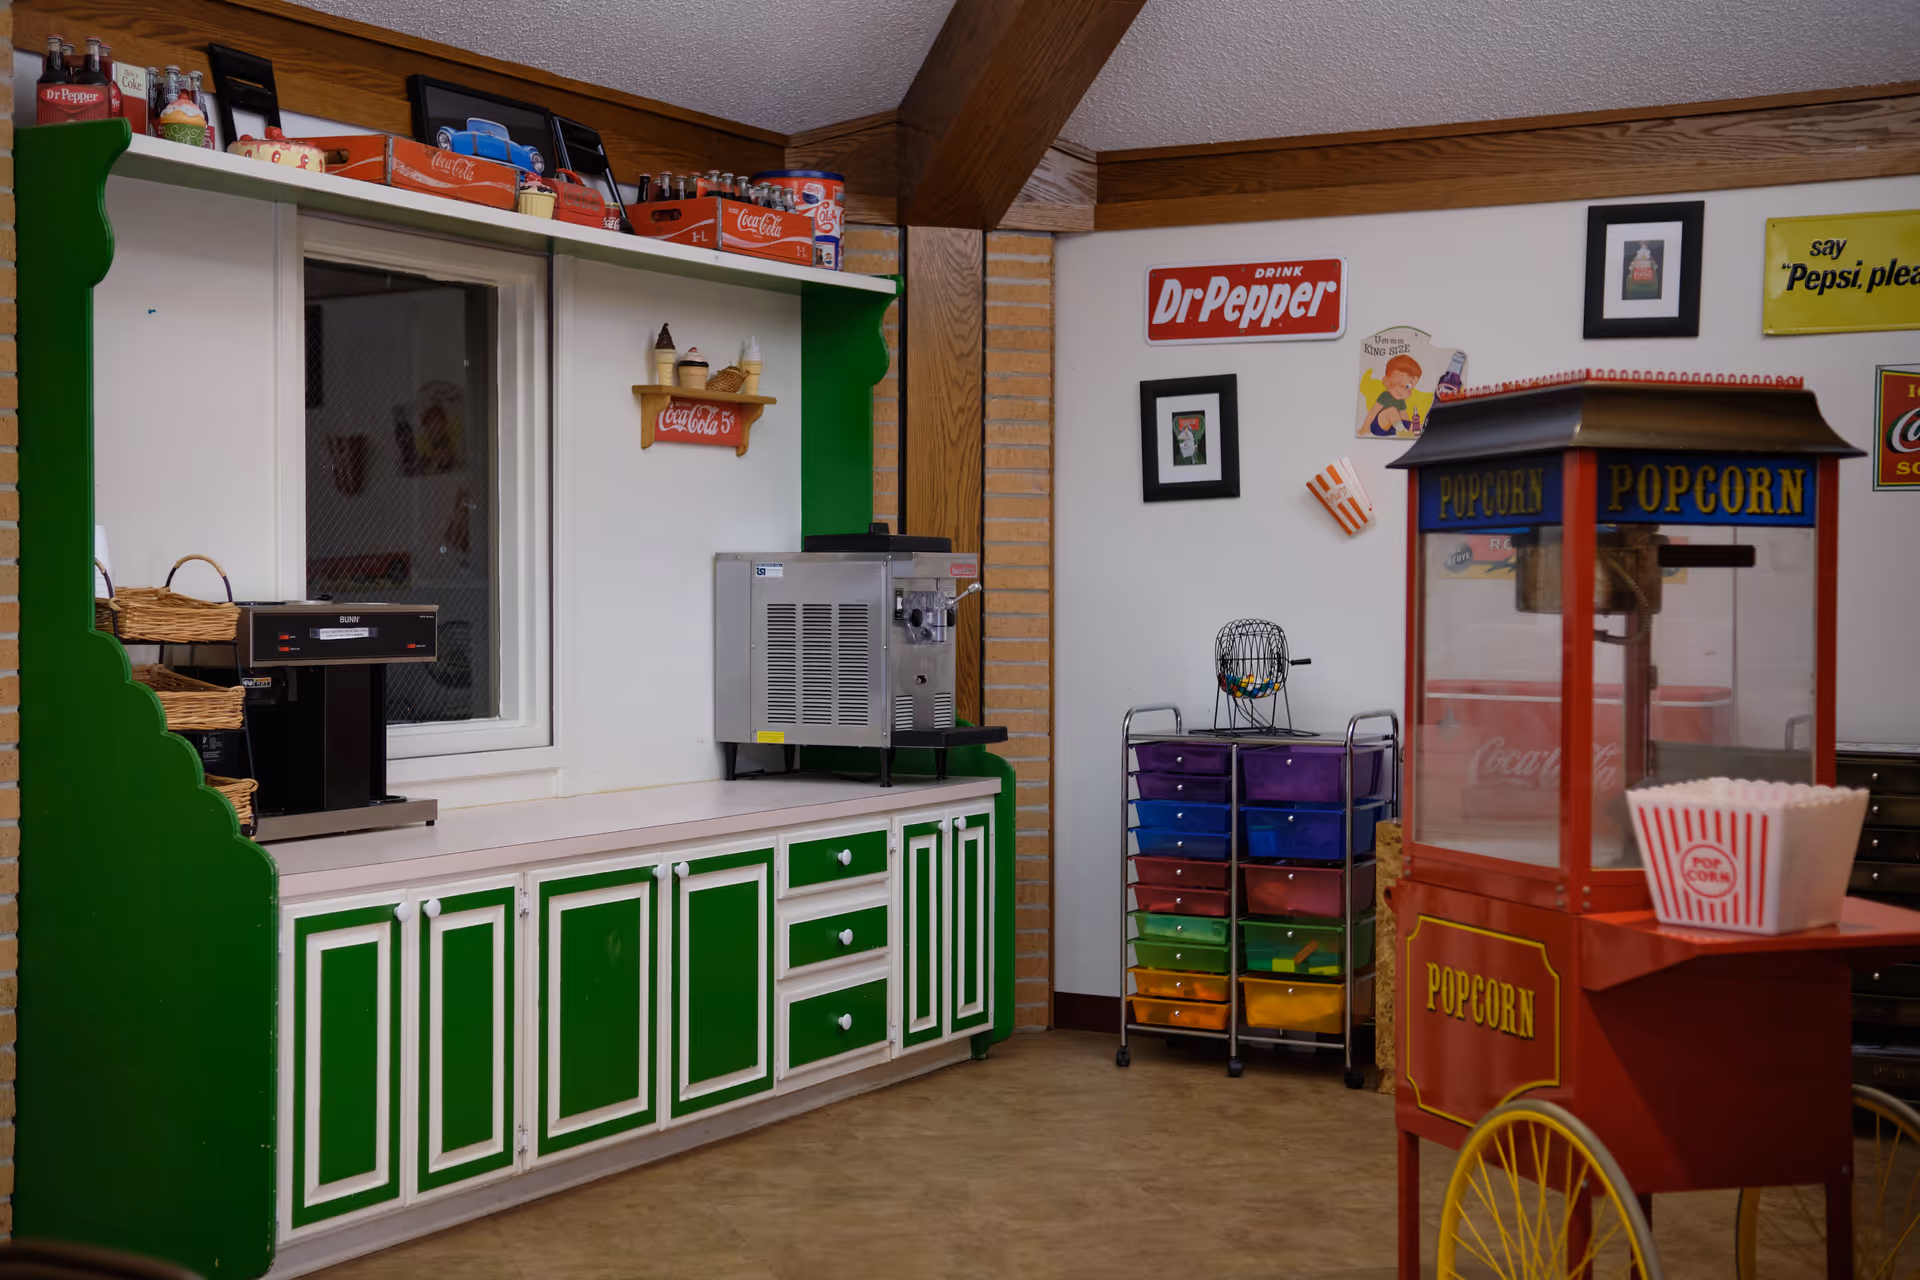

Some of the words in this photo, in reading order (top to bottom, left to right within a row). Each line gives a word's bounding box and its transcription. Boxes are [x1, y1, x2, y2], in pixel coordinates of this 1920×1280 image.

[122, 76, 143, 91] Coke
[1810, 238, 1847, 260] say
[1254, 266, 1304, 279] DRINK
[1364, 343, 1386, 357] KING
[1389, 344, 1411, 356] SIZE
[1438, 467, 1544, 519] POPCORN
[1607, 463, 1806, 514] POPCORN
[340, 616, 359, 624] BUNN
[1692, 857, 1721, 870] POP
[1687, 870, 1730, 884] CORN
[1426, 961, 1535, 1041] POPCORN
